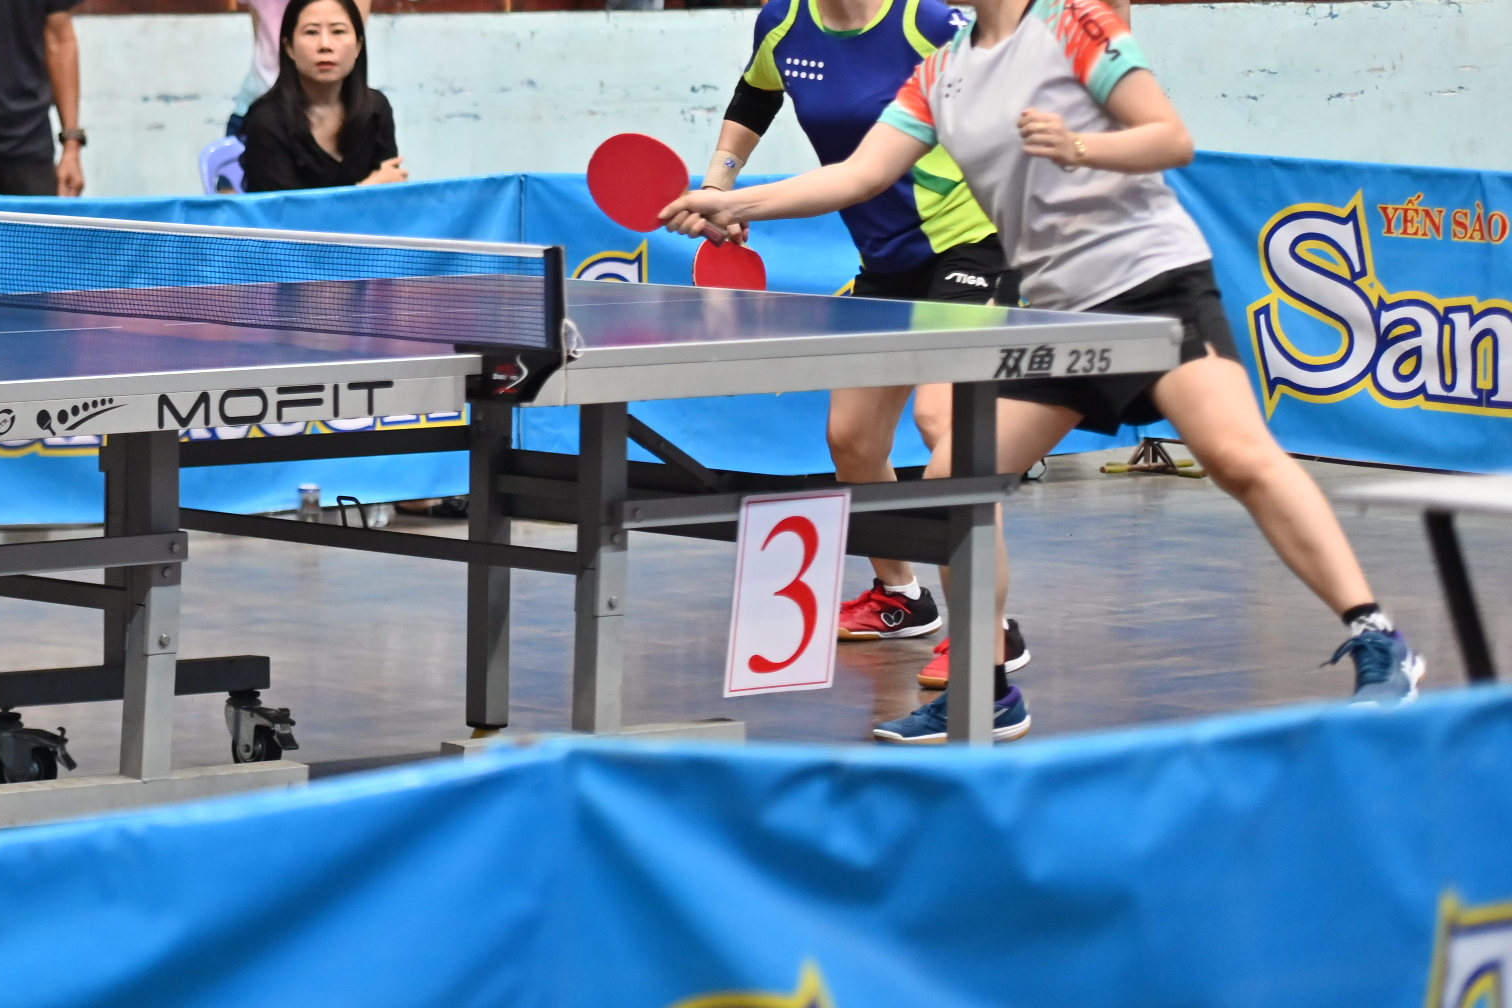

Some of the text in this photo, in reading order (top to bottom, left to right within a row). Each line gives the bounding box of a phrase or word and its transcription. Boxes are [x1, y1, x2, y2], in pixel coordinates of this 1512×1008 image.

[1377, 192, 1510, 244] YẾN SÀO
[944, 272, 989, 288] STIGA
[993, 344, 1113, 378] 双鱼 235
[157, 380, 394, 430] MOFIT
[748, 515, 820, 674] 3
